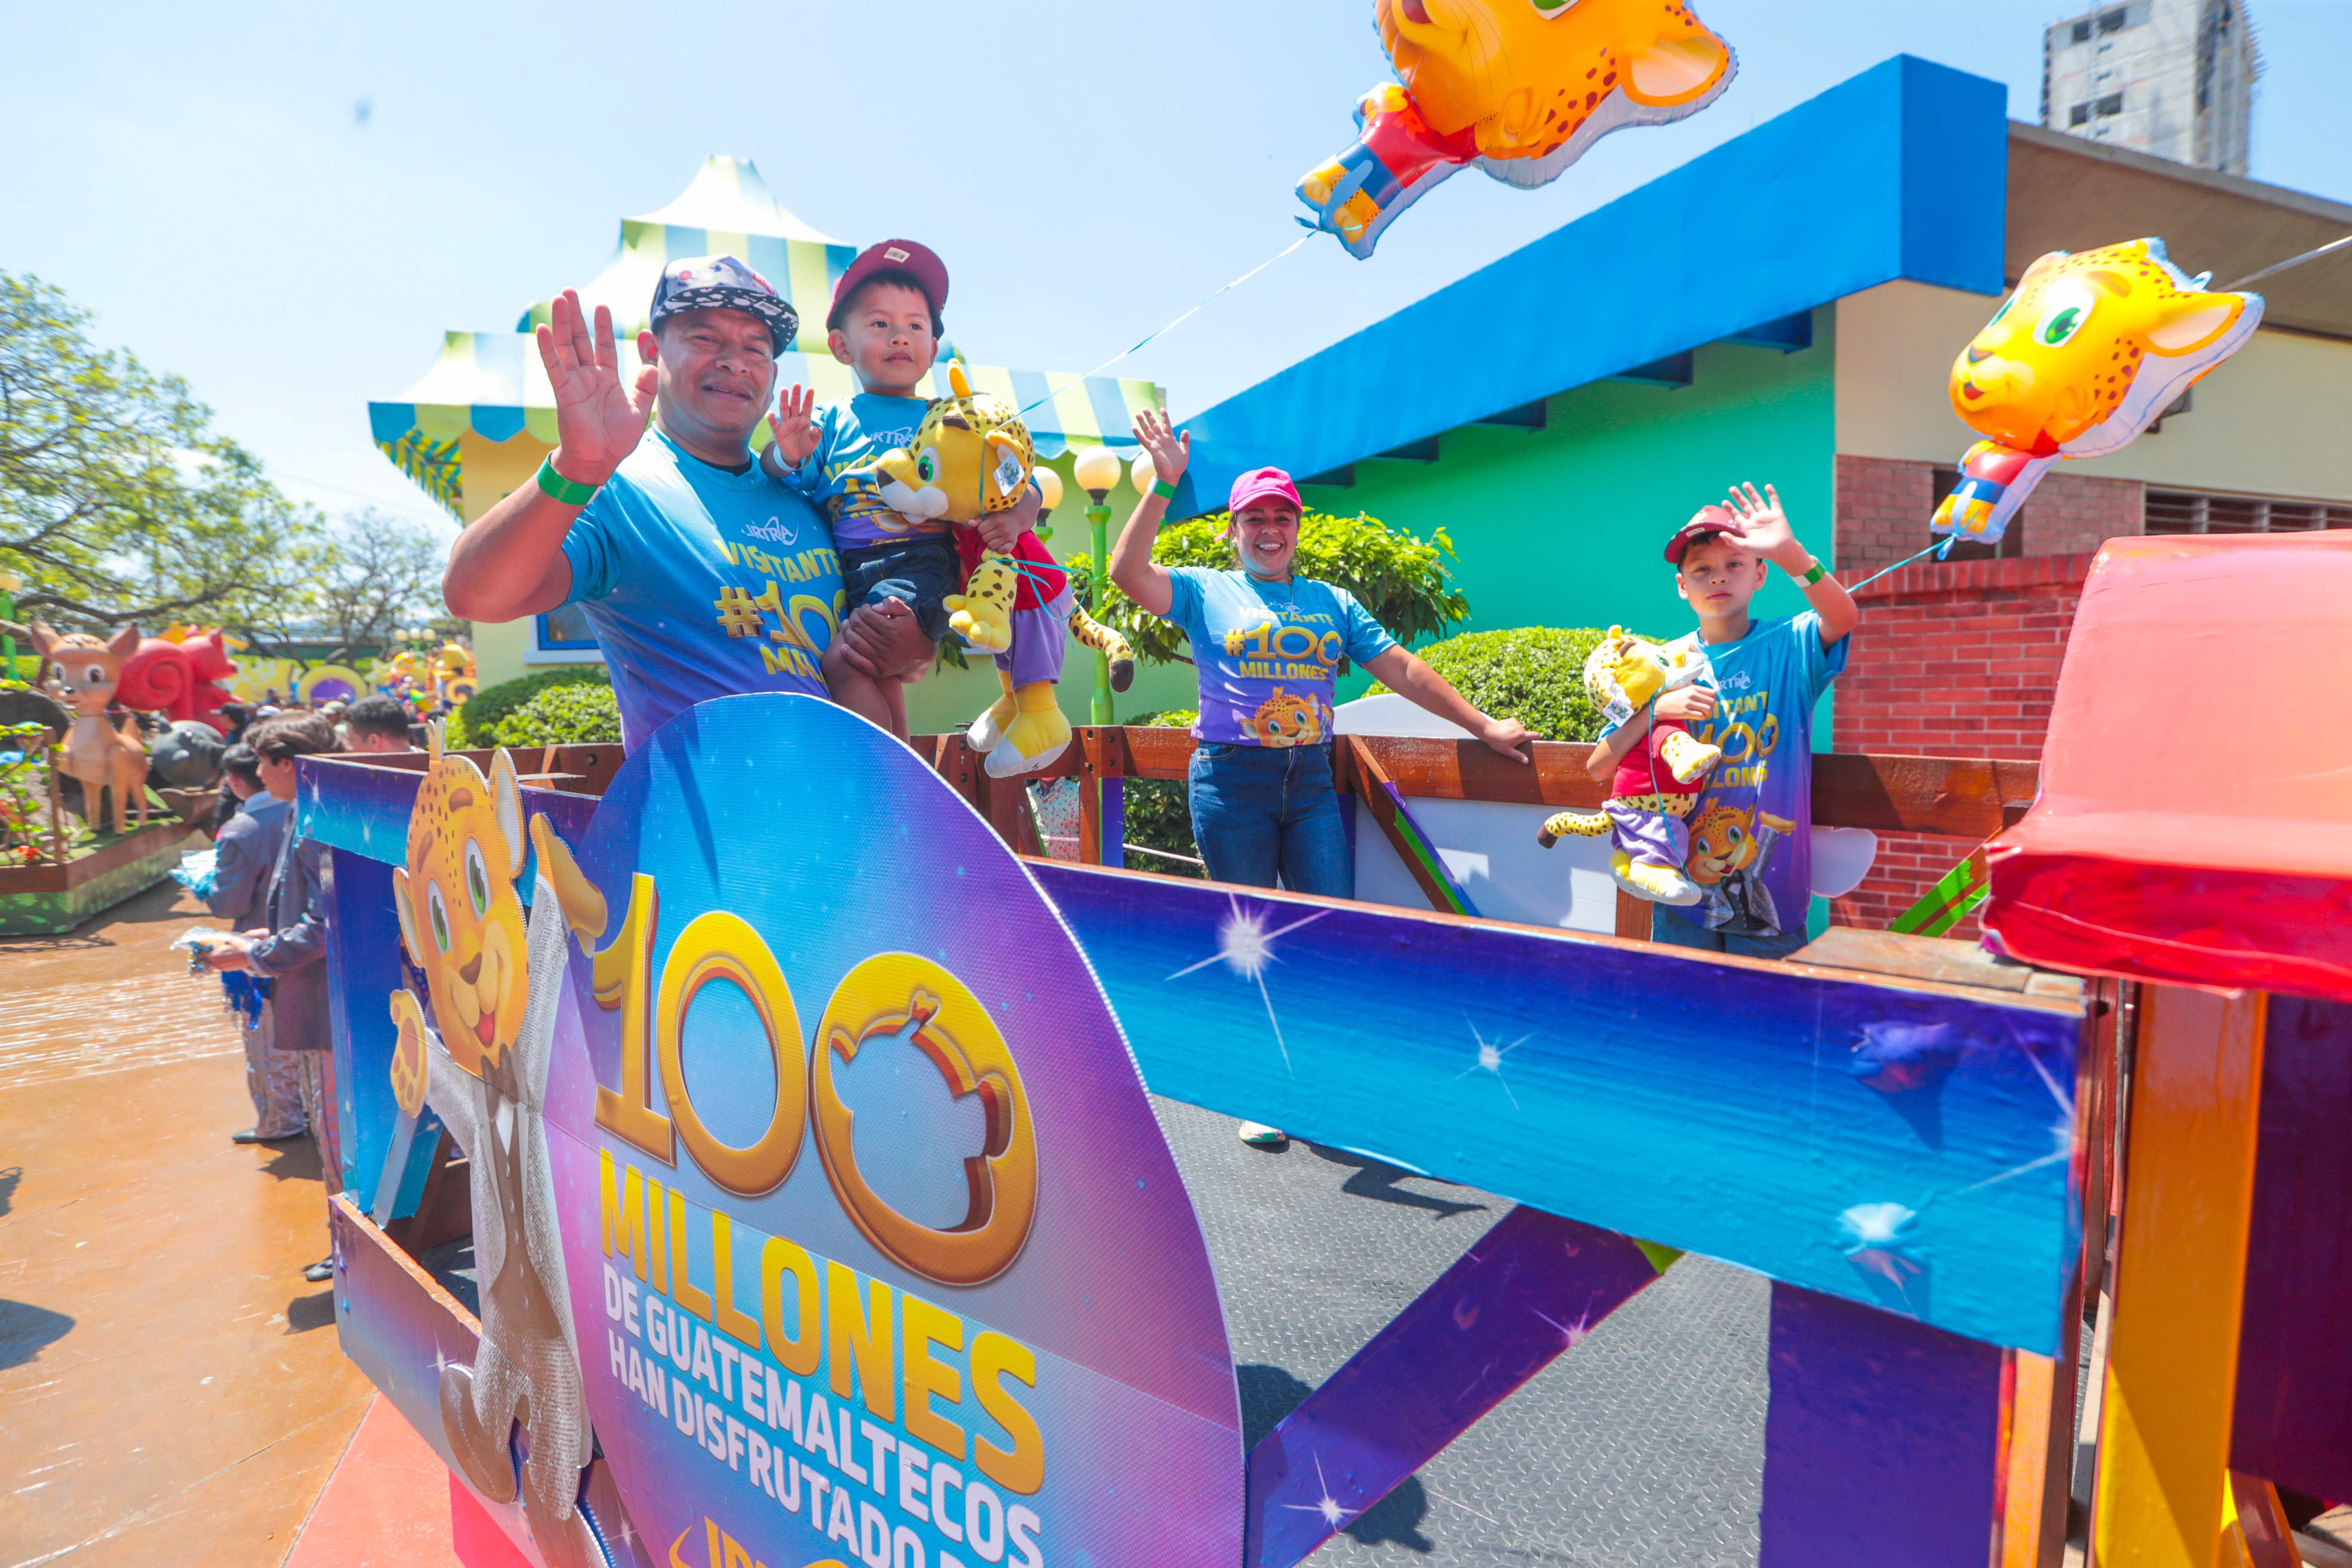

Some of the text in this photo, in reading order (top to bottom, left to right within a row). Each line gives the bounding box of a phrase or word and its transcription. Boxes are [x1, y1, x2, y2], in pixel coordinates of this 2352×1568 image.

[1224, 621, 1342, 666] #100
[1239, 661, 1329, 681] MILLONES
[592, 871, 1039, 1286] 100
[600, 1146, 1044, 1495] MILLONES
[603, 1262, 1044, 1568] DE GUATEMALTECOS
[608, 1328, 668, 1420] HAN
